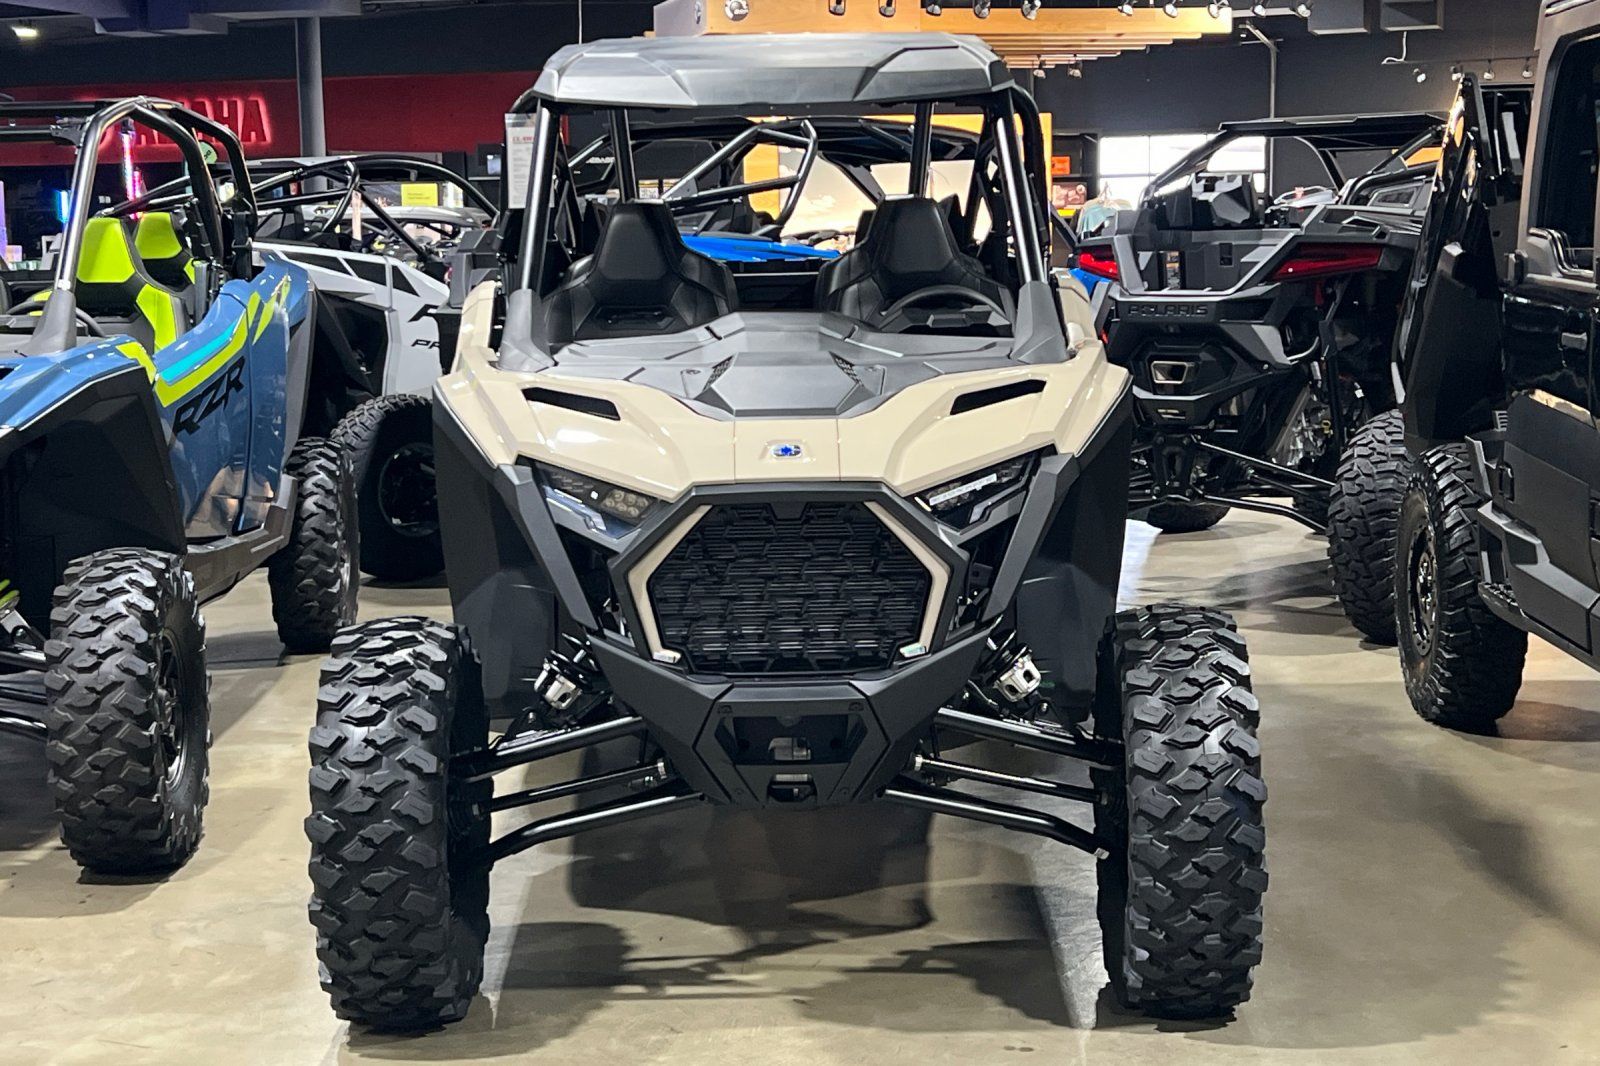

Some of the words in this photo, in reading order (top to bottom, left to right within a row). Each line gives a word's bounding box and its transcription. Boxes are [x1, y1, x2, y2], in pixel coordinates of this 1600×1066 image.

[126, 98, 270, 145] AHA
[1128, 304, 1208, 317] POLARIS
[172, 355, 246, 436] RZR
